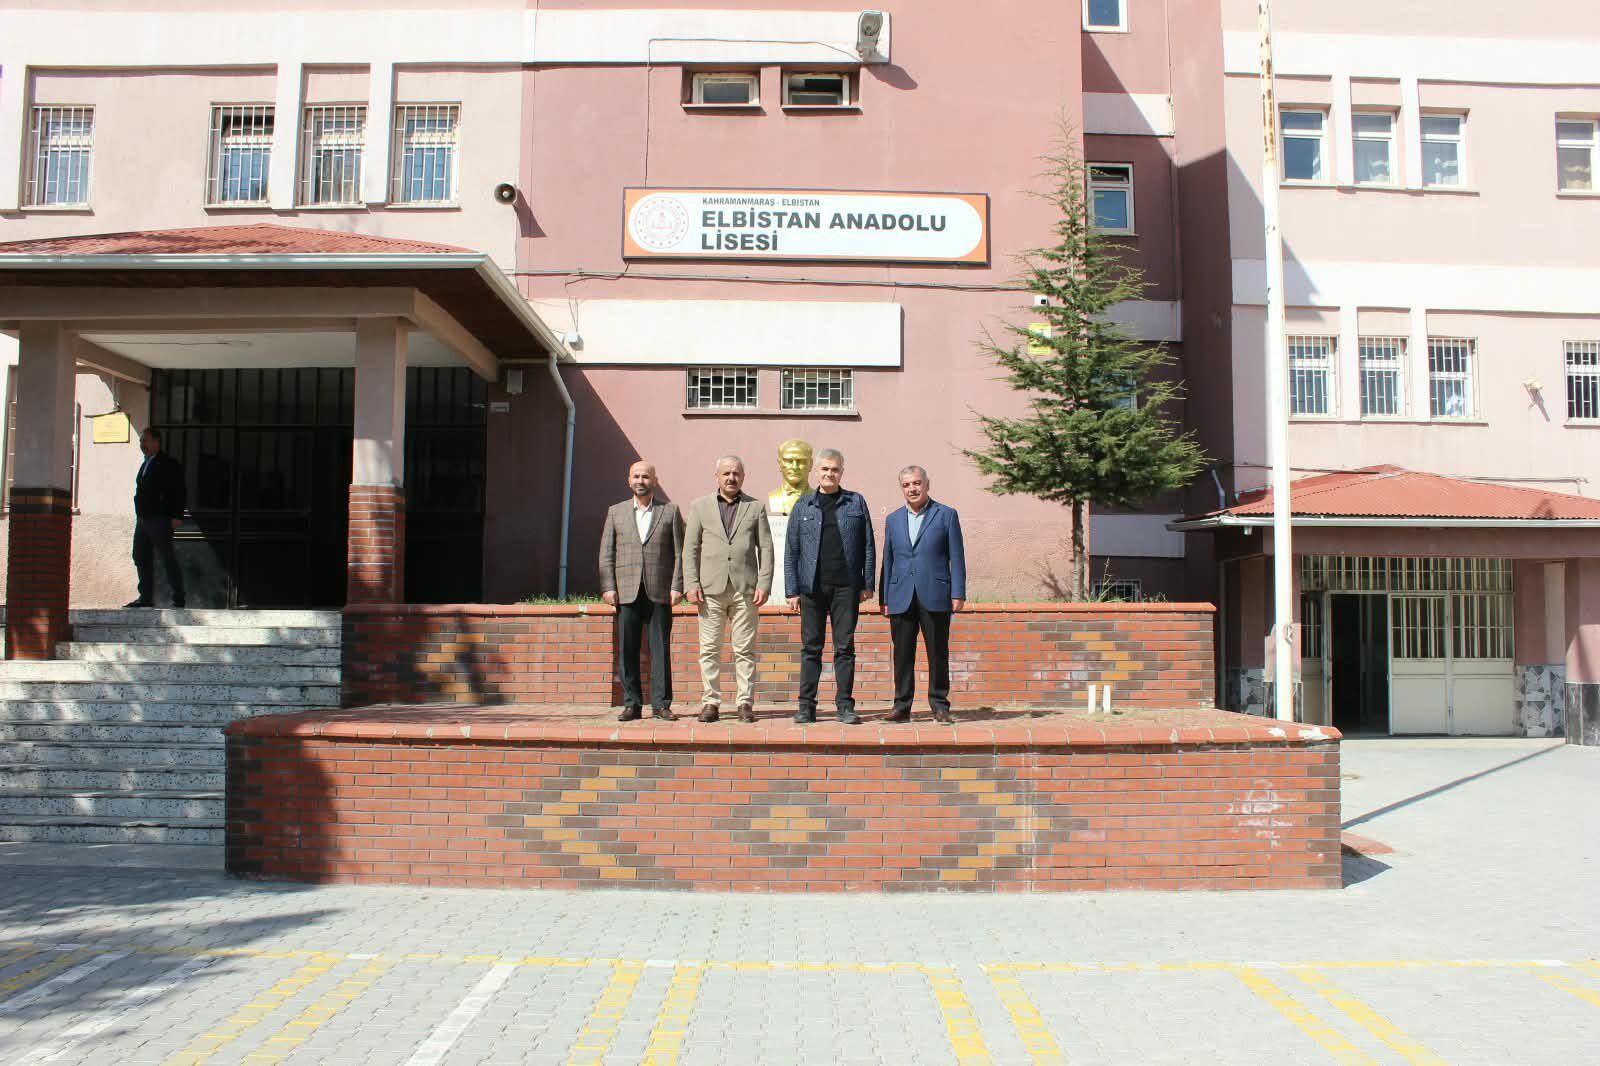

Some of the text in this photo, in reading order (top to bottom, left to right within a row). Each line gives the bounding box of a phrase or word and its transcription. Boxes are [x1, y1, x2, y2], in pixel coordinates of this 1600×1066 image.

[702, 197, 775, 208] KAHRAMANMARAŞ
[702, 207, 946, 231] ELBİSTAN ANADOLU
[701, 230, 778, 251] LİSESİ
